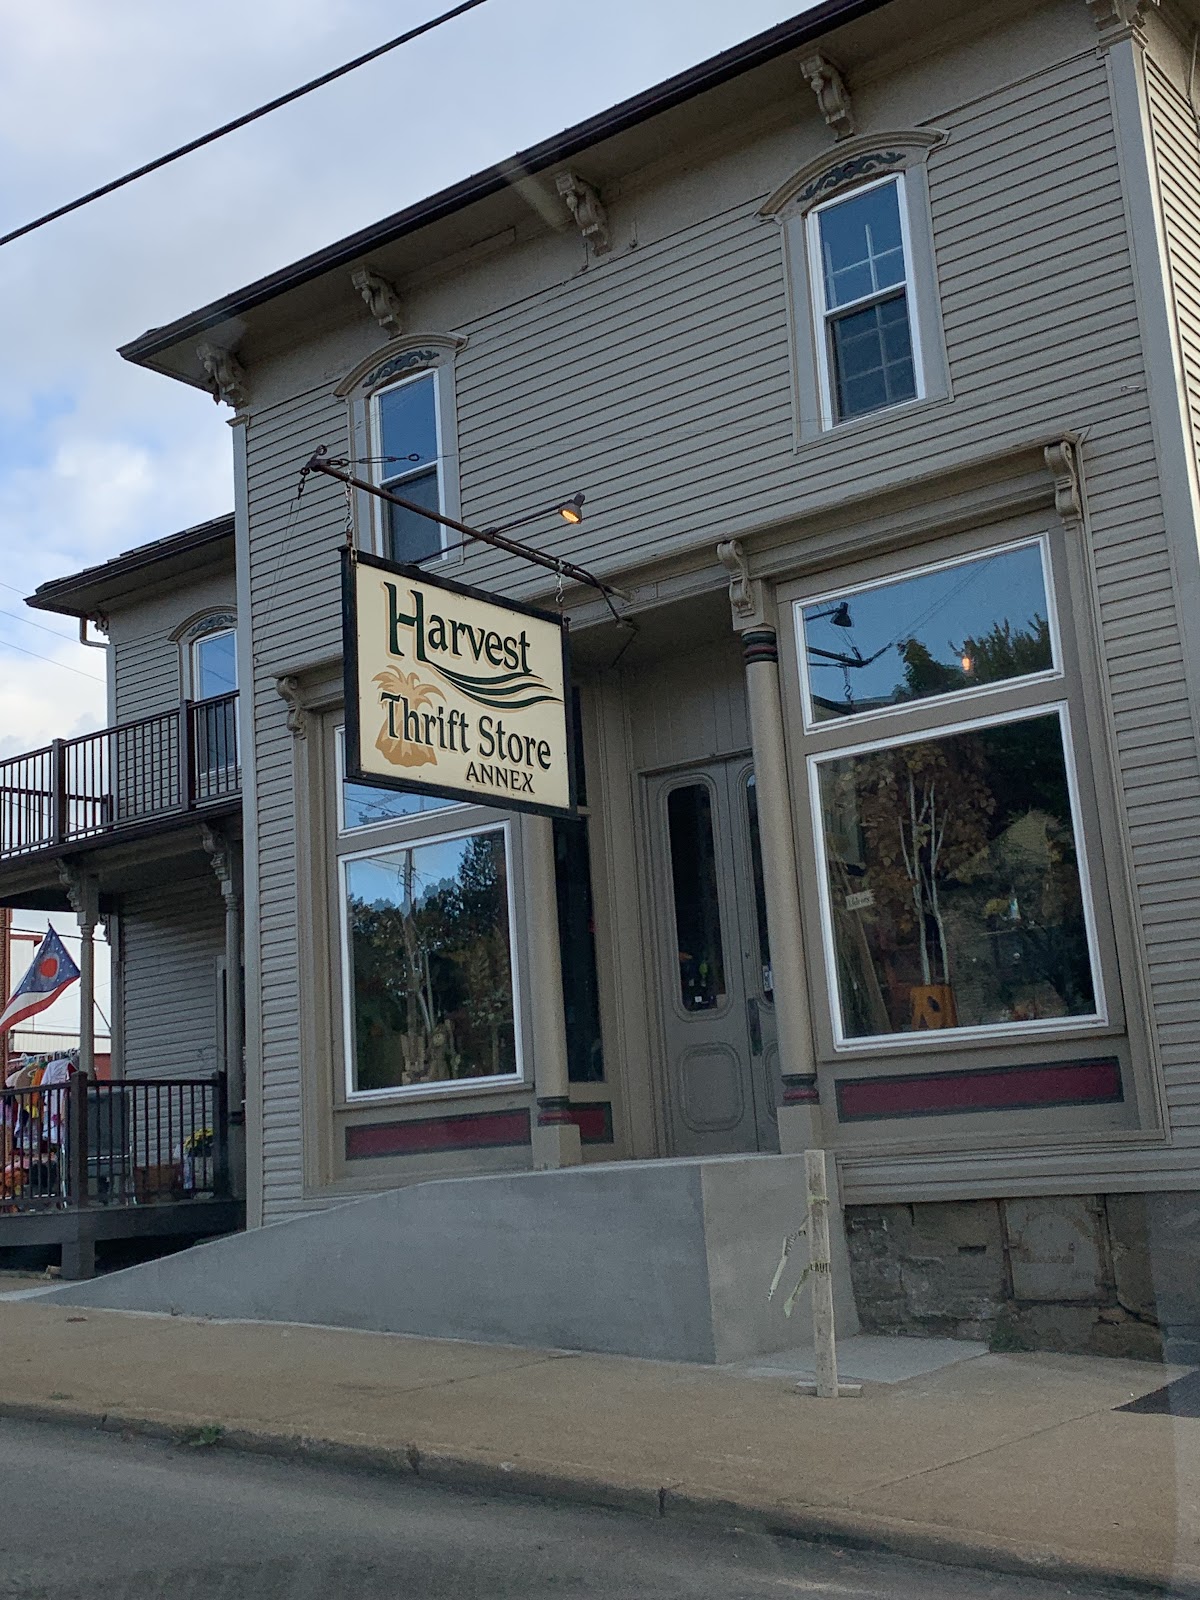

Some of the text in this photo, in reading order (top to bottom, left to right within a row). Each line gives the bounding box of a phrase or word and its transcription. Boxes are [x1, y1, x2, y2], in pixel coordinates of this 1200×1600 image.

[383, 581, 533, 673] Harvest
[380, 692, 551, 770] Thrift Store
[466, 761, 535, 793] ANNEX
